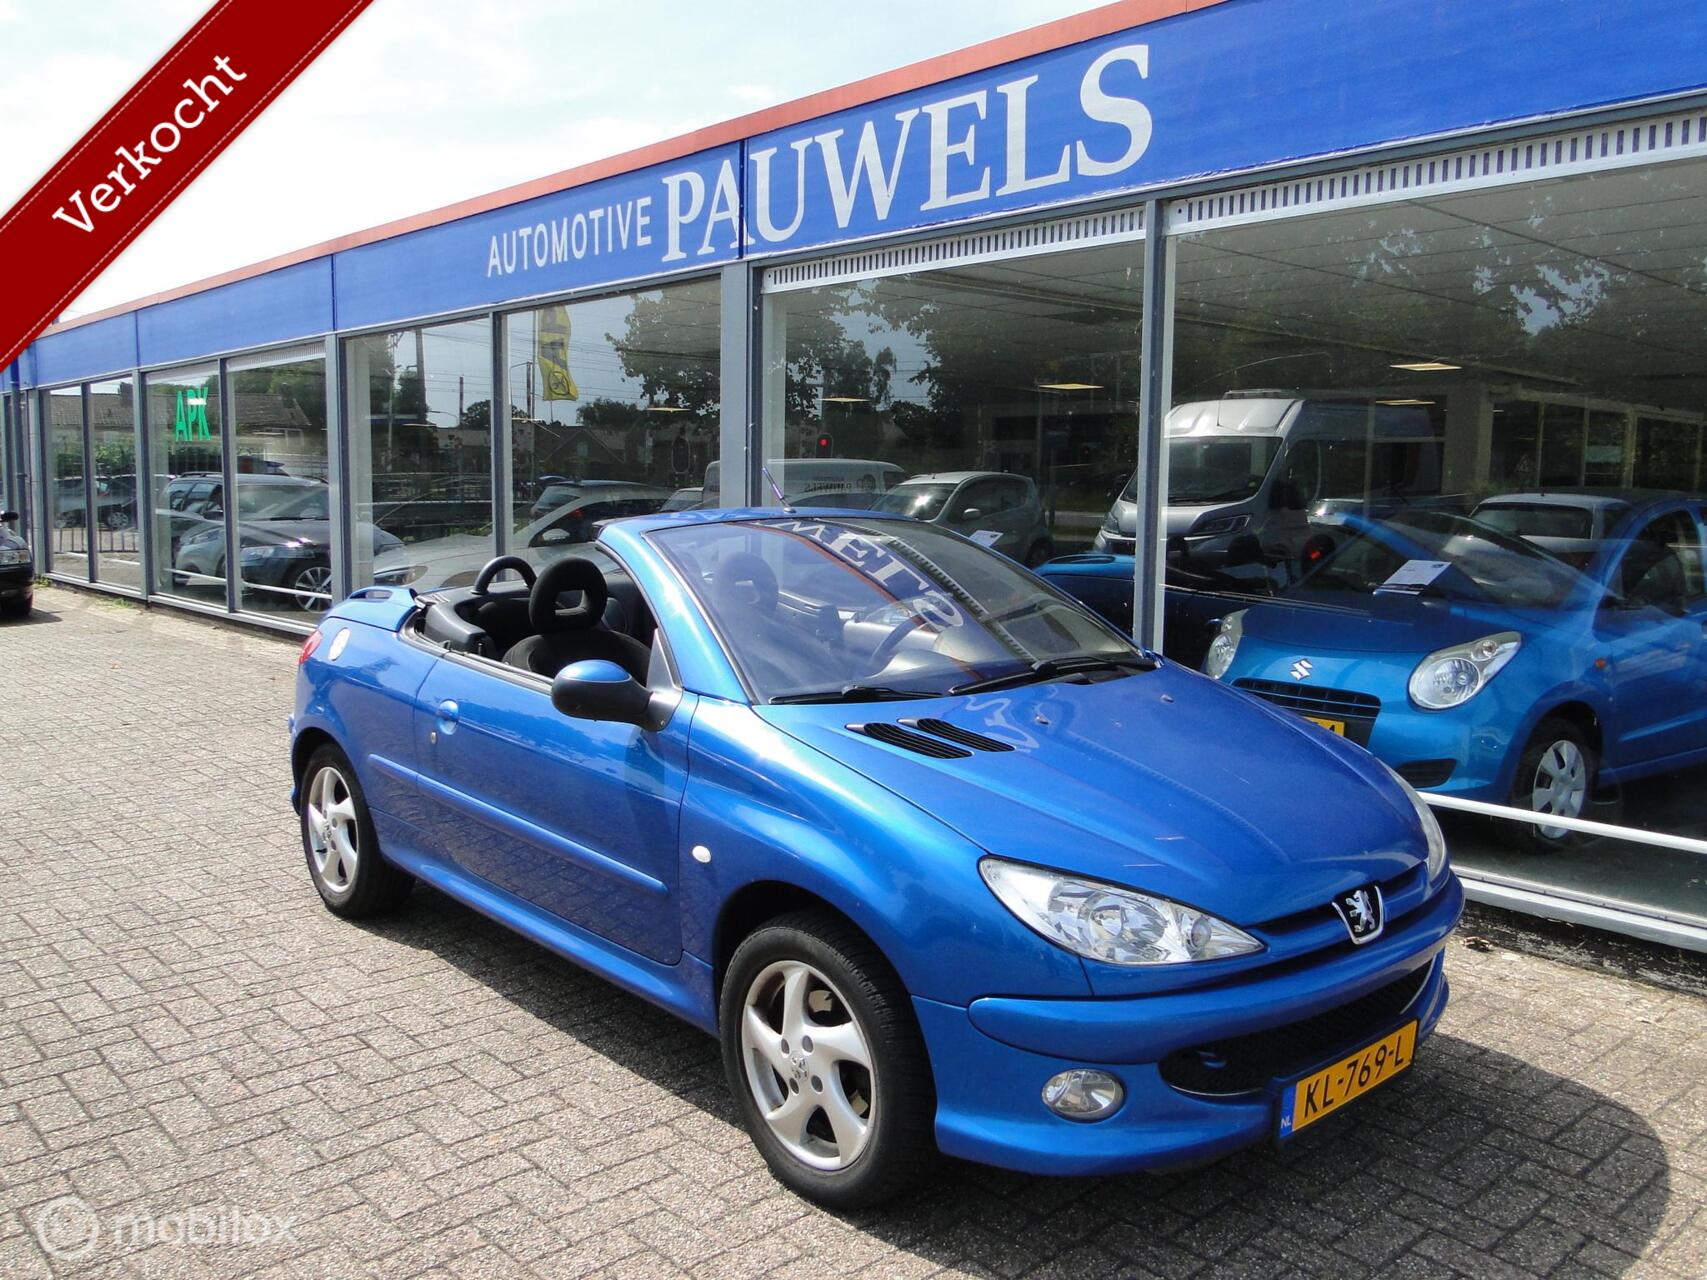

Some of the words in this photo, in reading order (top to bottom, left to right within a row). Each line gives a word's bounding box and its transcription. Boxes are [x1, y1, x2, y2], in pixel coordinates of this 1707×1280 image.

[488, 196, 652, 277] AUTOMOTIVE
[662, 44, 1153, 263] PAUWELS
[175, 387, 211, 441] APK
[1304, 1035, 1404, 1118] KL-769-L
[1281, 1116, 1292, 1129] NL
